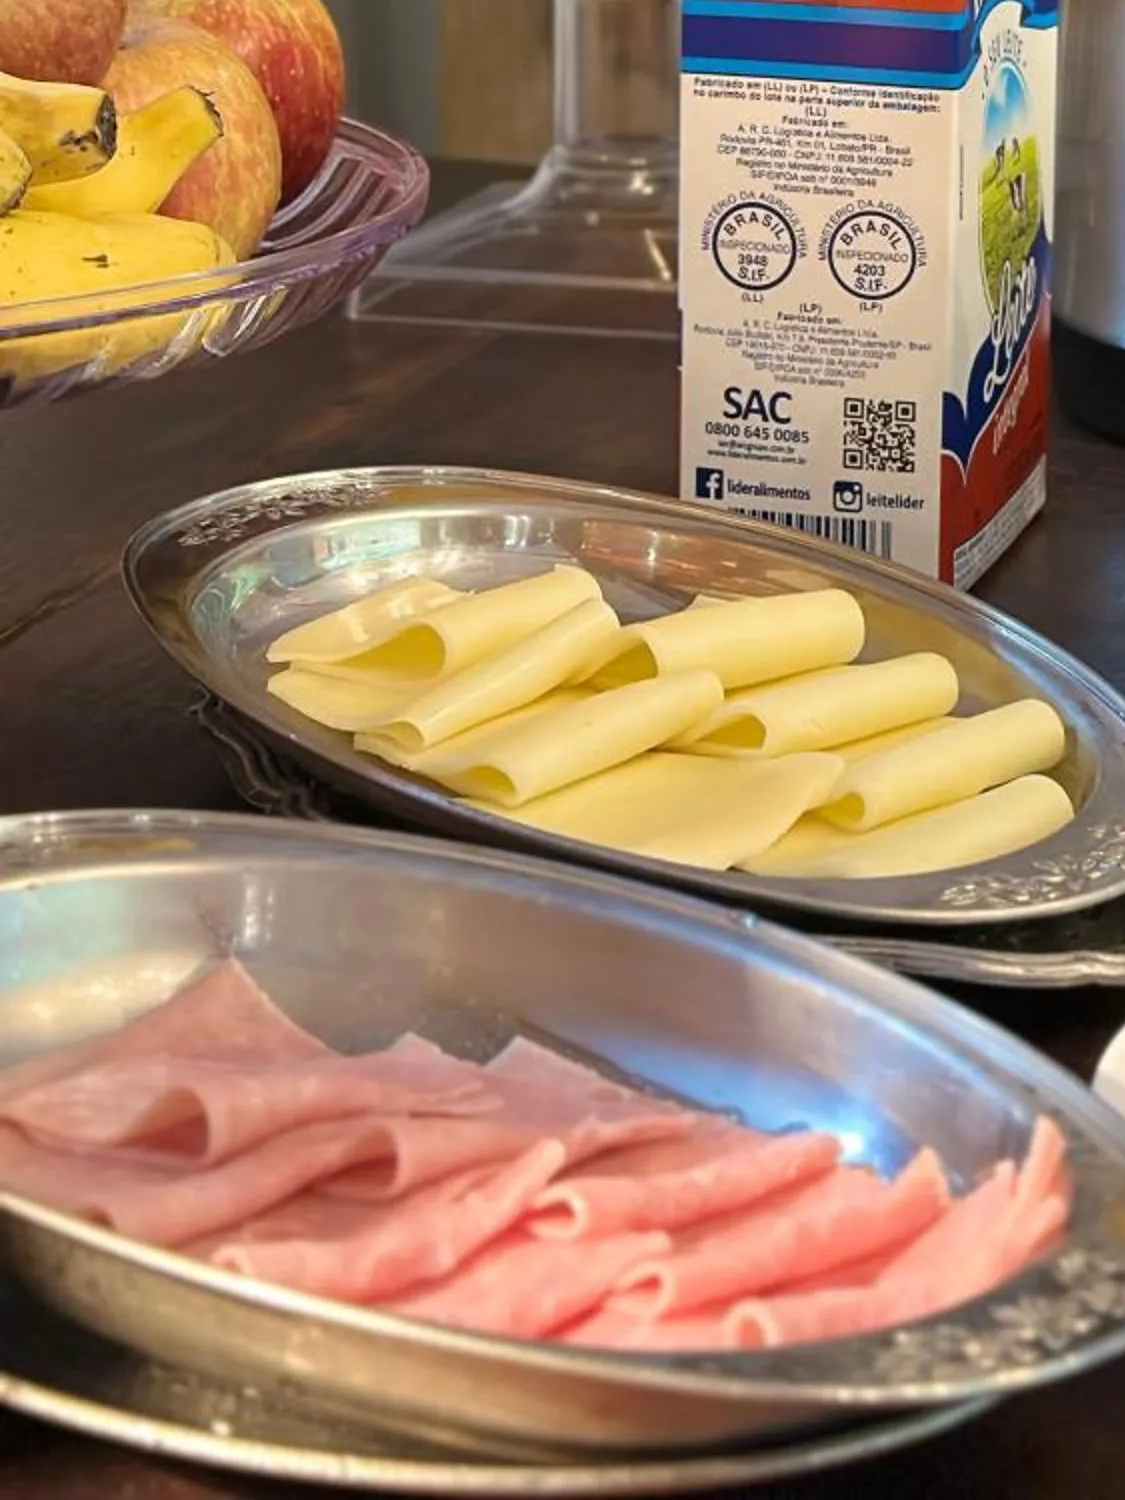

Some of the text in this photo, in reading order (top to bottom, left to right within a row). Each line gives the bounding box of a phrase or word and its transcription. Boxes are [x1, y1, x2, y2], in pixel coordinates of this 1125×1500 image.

[724, 212, 786, 241] BRASIL
[840, 220, 902, 251] BRASIL
[853, 264, 886, 277] 4203
[723, 386, 793, 425] SAC
[705, 421, 810, 443] 0800 645 0085
[727, 479, 811, 501] lideralimentos
[866, 492, 925, 509] leitelider
